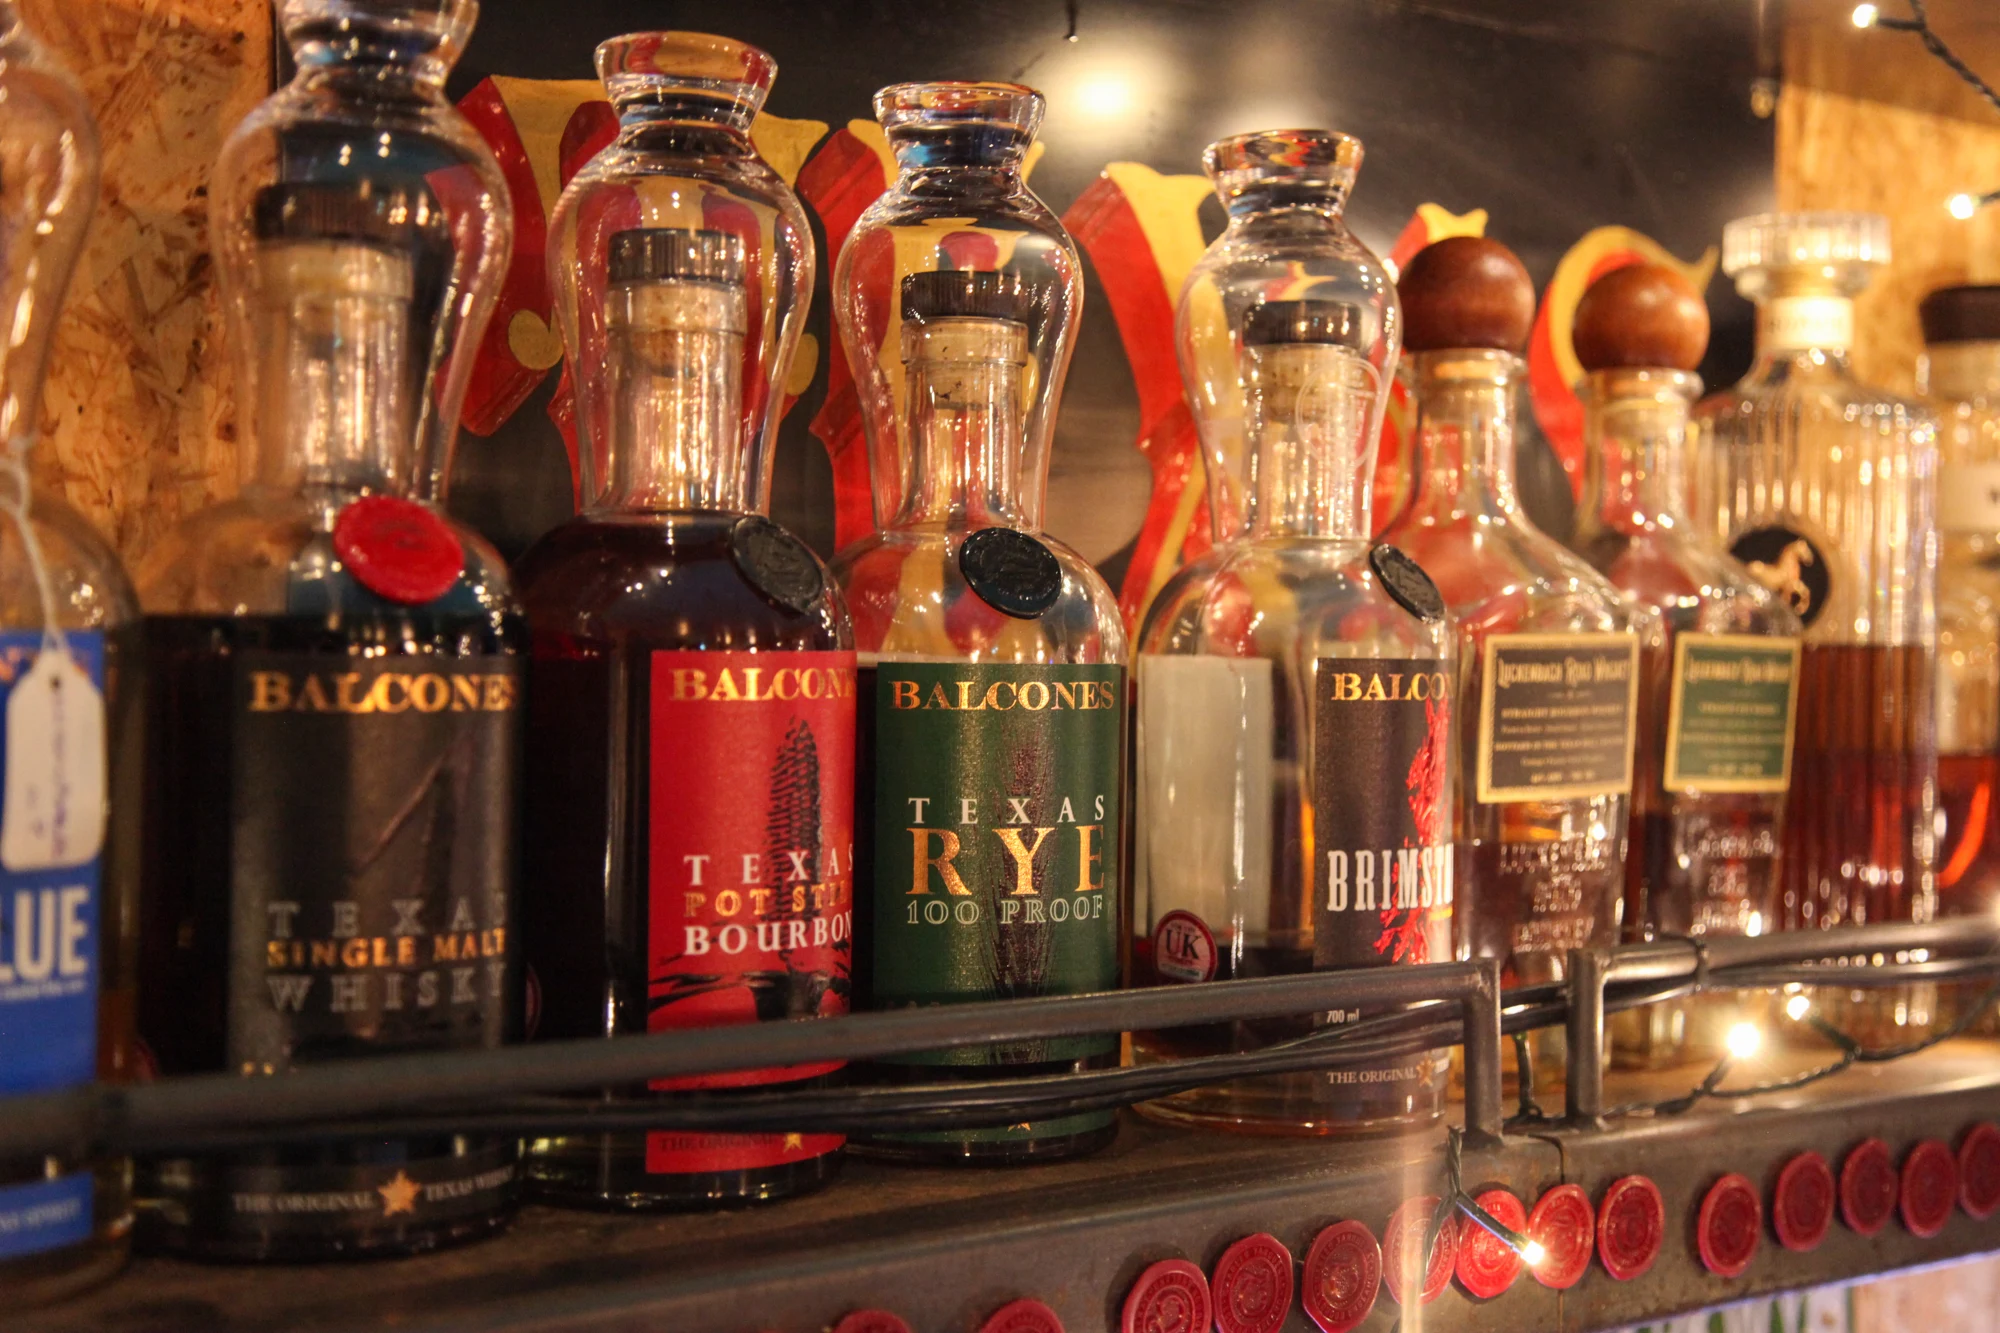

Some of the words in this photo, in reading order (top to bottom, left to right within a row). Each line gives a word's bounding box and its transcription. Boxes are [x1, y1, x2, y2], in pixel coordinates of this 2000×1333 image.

[889, 681, 1115, 711] BALCONES
[908, 795, 1105, 825] TEXAS
[683, 843, 853, 886] TEXAS
[905, 824, 1105, 896] RYE
[684, 888, 771, 917] POT
[907, 899, 980, 925] 100
[1000, 894, 1103, 924] PROOF
[0, 886, 89, 983] UE
[267, 936, 416, 968] SINGLE
[433, 927, 506, 962] MALT
[684, 910, 852, 956] BOURBON
[1166, 929, 1202, 959] UK
[267, 962, 506, 1012] WHISKY
[1327, 1010, 1344, 1023] 700
[1347, 1008, 1360, 1022] ml
[1327, 1071, 1357, 1084] THE
[1359, 1067, 1416, 1083] ORIGINAL
